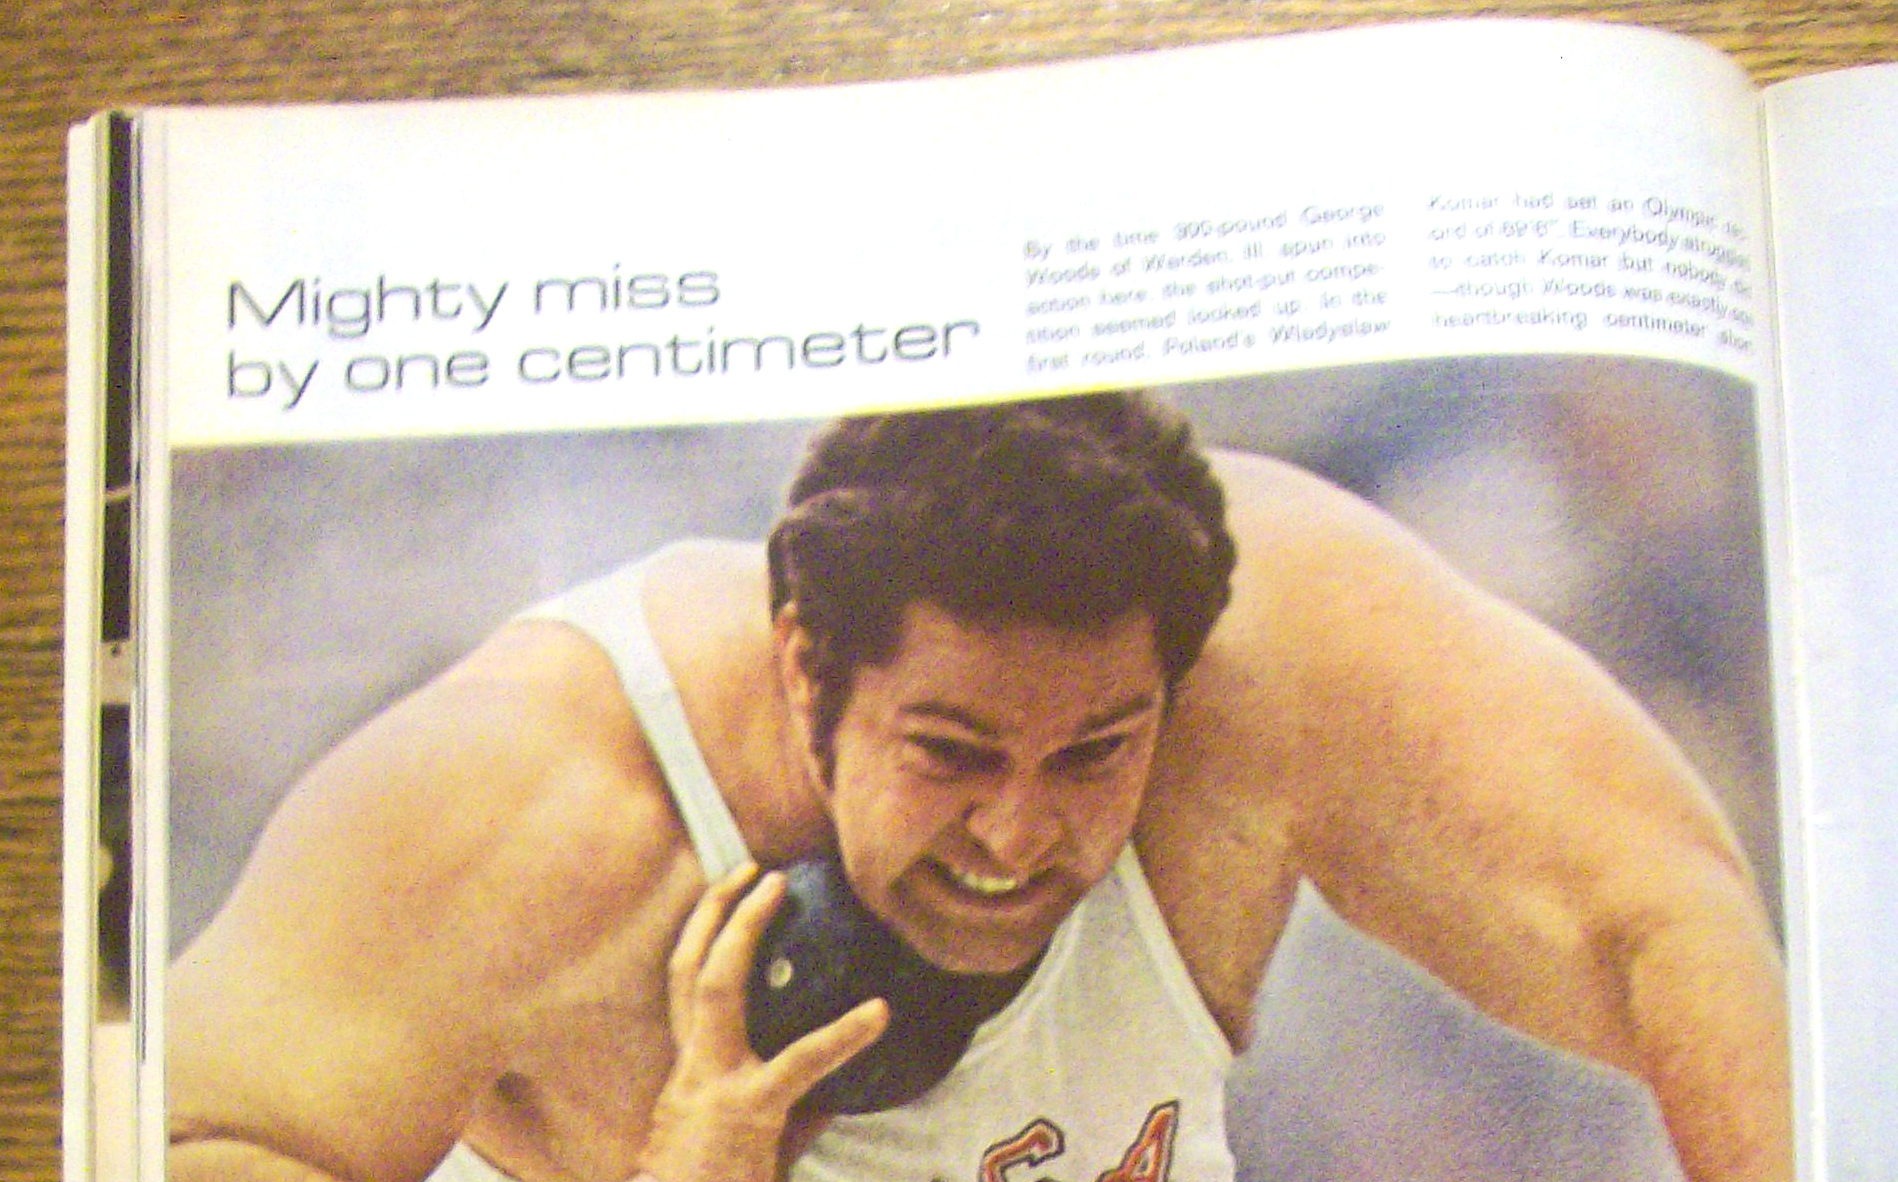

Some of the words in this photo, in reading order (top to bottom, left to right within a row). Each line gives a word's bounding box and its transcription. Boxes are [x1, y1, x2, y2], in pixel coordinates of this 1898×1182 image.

[1023, 240, 1052, 261] By
[1066, 237, 1100, 254] the
[1113, 231, 1160, 248] time
[1300, 205, 1384, 226] George
[1427, 194, 1498, 212] Komar
[1512, 192, 1554, 209] had
[1563, 195, 1597, 211] set
[1607, 198, 1634, 213] an
[1642, 196, 1717, 229] Olympic
[1026, 262, 1100, 288] Woods
[1110, 257, 1131, 277] of
[1279, 238, 1333, 260] spun
[1343, 231, 1386, 250] into
[1428, 221, 1466, 241] ord
[1474, 221, 1494, 239] of
[1569, 220, 1678, 253] Everybody
[1428, 255, 1452, 270] to
[1464, 250, 1526, 268] catch
[1537, 247, 1608, 268] Komar
[1618, 252, 1653, 272] but
[1661, 261, 1726, 291] nobody
[228, 275, 510, 338] Mighty
[532, 262, 722, 314] miss
[1025, 296, 1091, 317] action
[1162, 281, 1197, 300] the
[1206, 270, 1295, 295] shot-put
[1092, 311, 1176, 337] seemed
[1188, 300, 1261, 325] locked
[1351, 289, 1388, 306] the
[1542, 277, 1616, 297] Woods
[1622, 286, 1663, 303] was
[1665, 292, 1727, 320] exactly
[1432, 308, 1587, 331] heartbreaking
[1602, 313, 1708, 338] centimeter
[227, 348, 320, 412] by
[342, 350, 491, 392] one
[516, 315, 980, 385] centimeter
